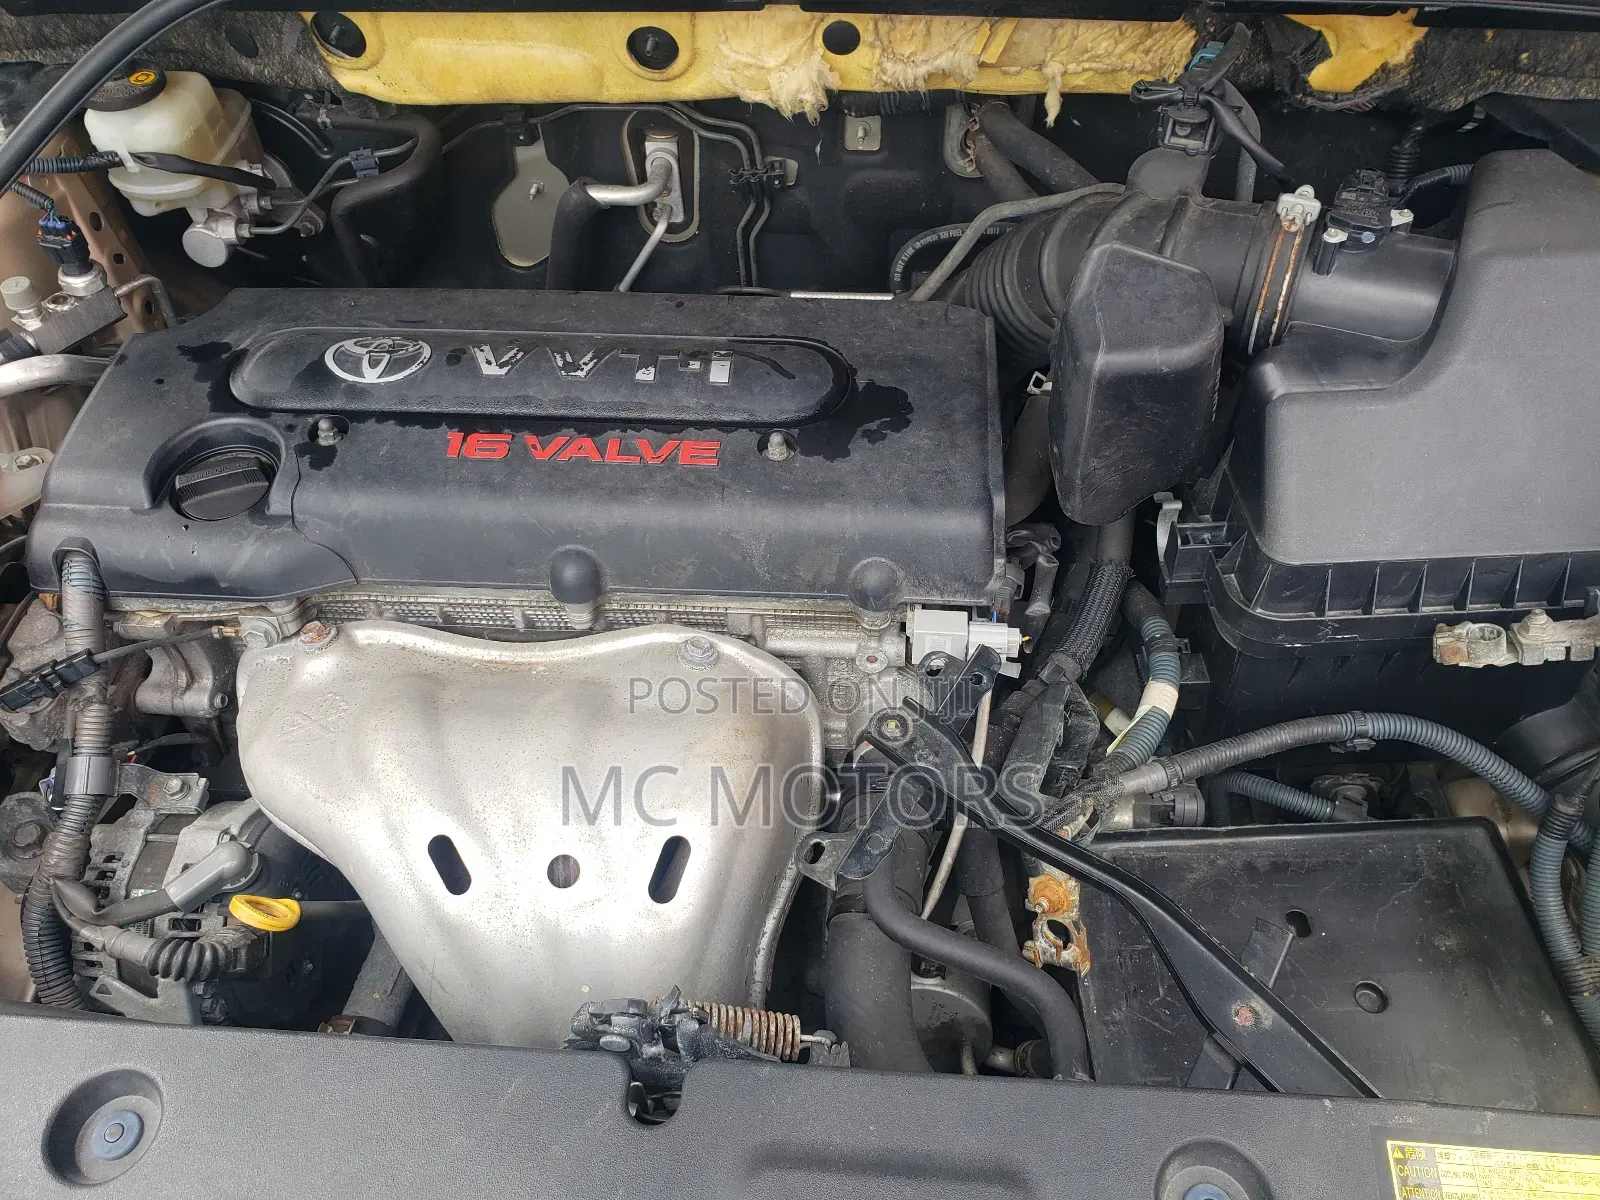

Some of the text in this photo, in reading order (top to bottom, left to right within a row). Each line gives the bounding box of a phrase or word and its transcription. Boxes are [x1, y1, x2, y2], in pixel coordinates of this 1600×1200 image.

[446, 431, 722, 466] 16 VALVE
[1397, 1164, 1439, 1179] CAUTION
[1401, 1186, 1442, 1200] ATTENTION
